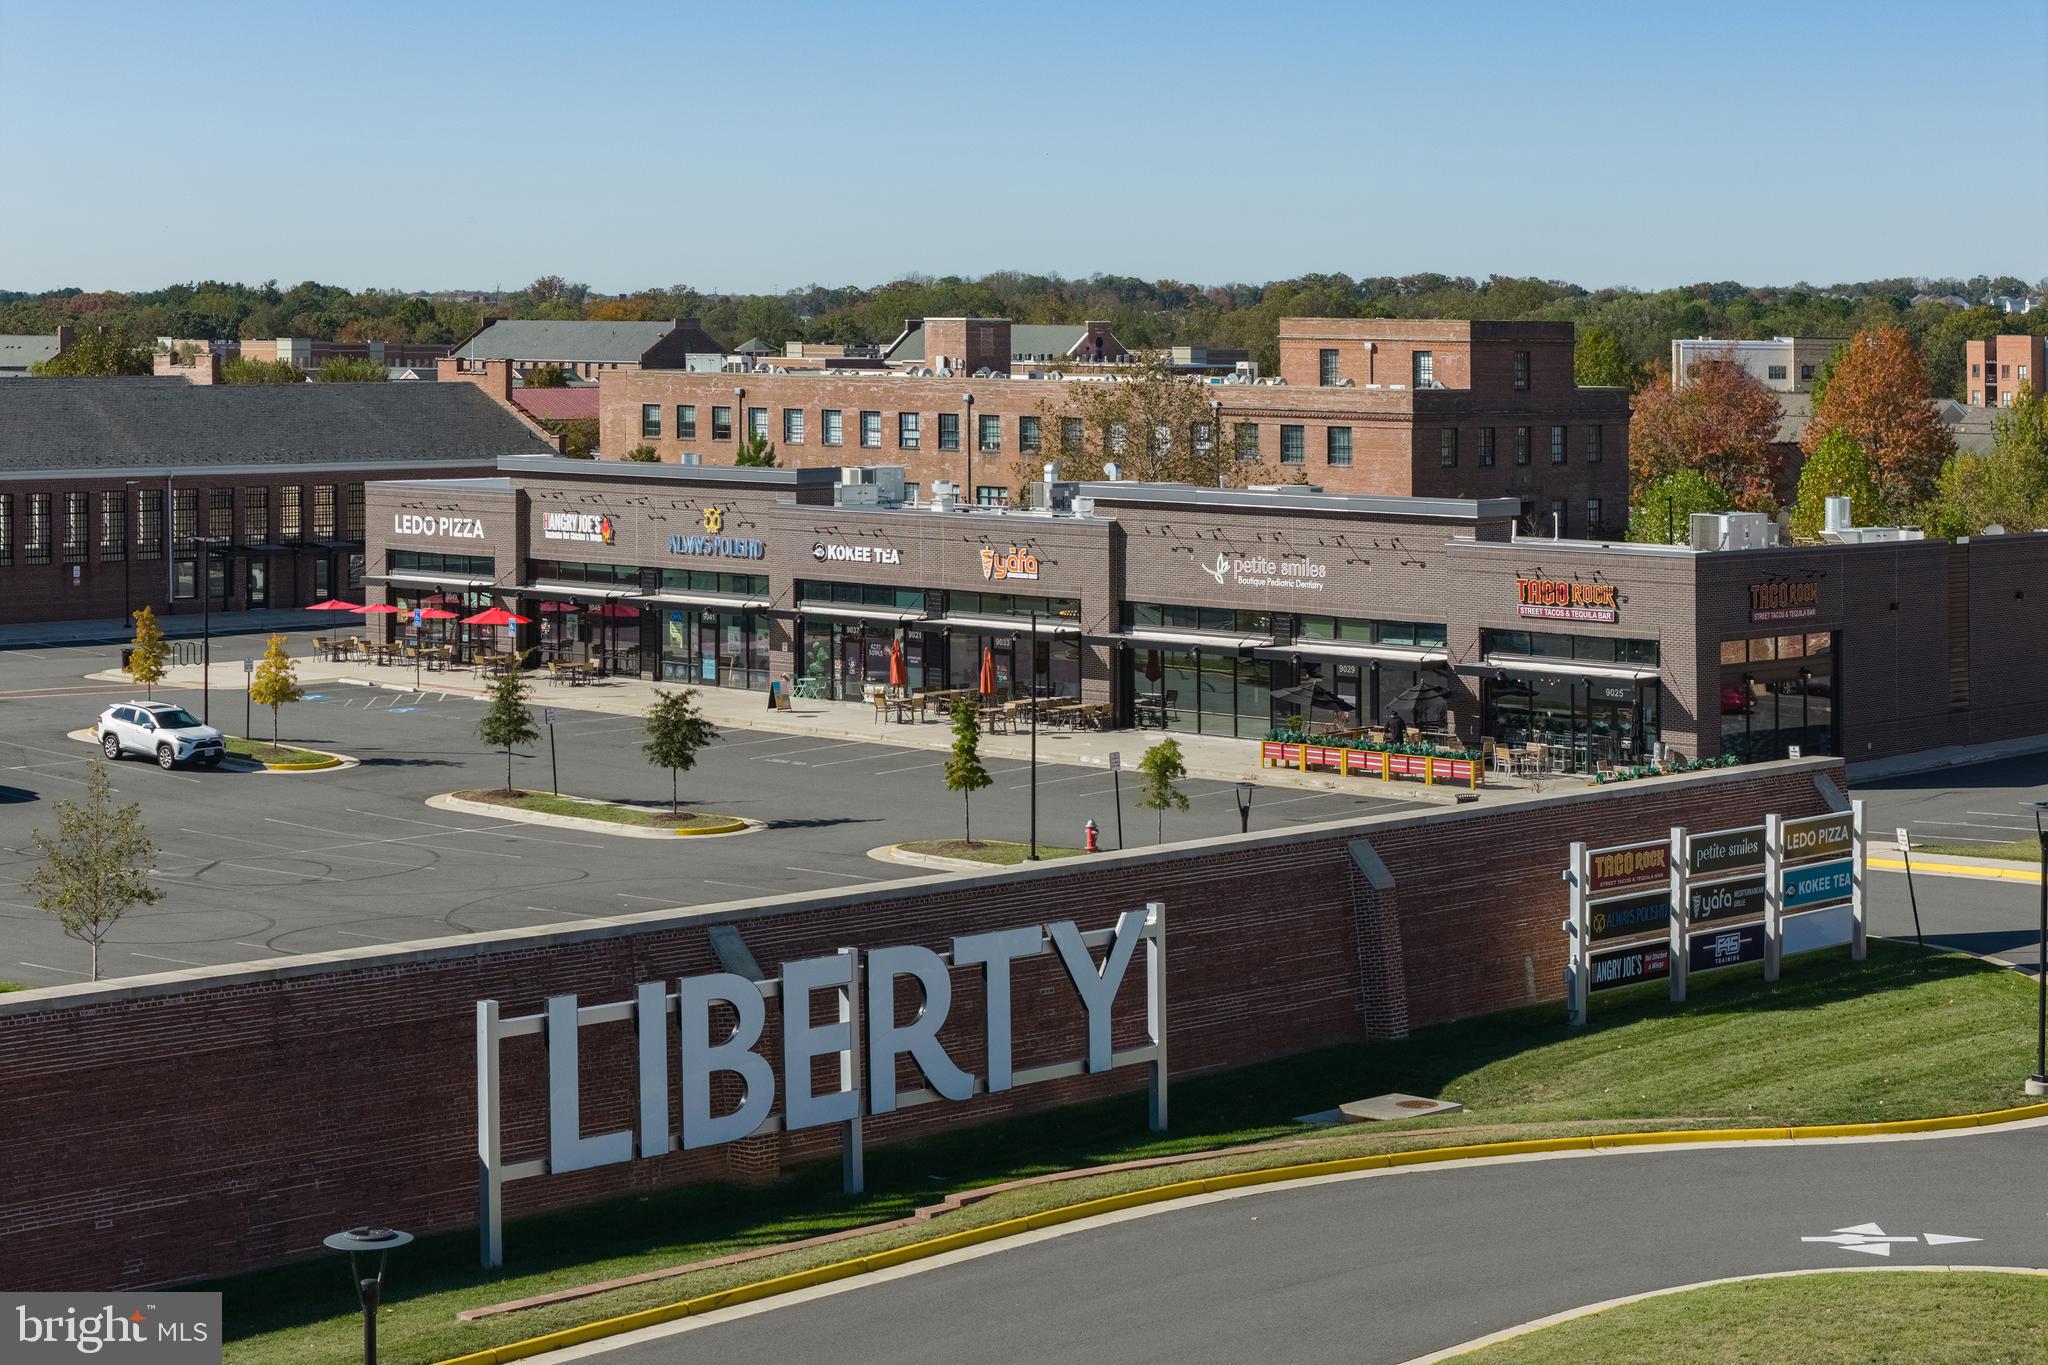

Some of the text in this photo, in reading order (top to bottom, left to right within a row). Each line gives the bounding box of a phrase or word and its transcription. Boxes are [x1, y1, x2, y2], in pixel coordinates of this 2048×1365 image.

[395, 514, 485, 539] LEDO PIZZA
[577, 514, 601, 534] JOE'S
[827, 545, 901, 565] KOKEE TEA
[1233, 556, 1327, 579] petite smiles
[1238, 575, 1324, 591] Boutique Pediatric Dentistry
[1516, 578, 1616, 608] TACO ROCK
[1750, 582, 1818, 609] TACO ROCK
[1520, 606, 1543, 615] STREET
[1544, 608, 1564, 617] TACOS
[1571, 610, 1598, 619] TEQUILA
[1598, 611, 1612, 620] BAR
[1754, 612, 1770, 620] STREET
[1771, 610, 1785, 619] TACOS
[1806, 608, 1816, 616] BAR
[846, 626, 860, 634] 9037
[908, 630, 922, 639] 9021
[1338, 664, 1356, 674] 9029
[1605, 688, 1624, 698] 9025
[1787, 825, 1849, 850] LEDO PIZZA
[1696, 837, 1759, 868] petite smiles
[1595, 849, 1666, 879] TACO ROCK
[1798, 872, 1851, 896] KOKEE TEA
[1607, 909, 1635, 928] ALWAYS
[1716, 932, 1741, 957] F45
[1622, 954, 1643, 978] JOE'S
[1715, 954, 1741, 965] TRAINING
[546, 909, 1150, 1174] LIBERTY
